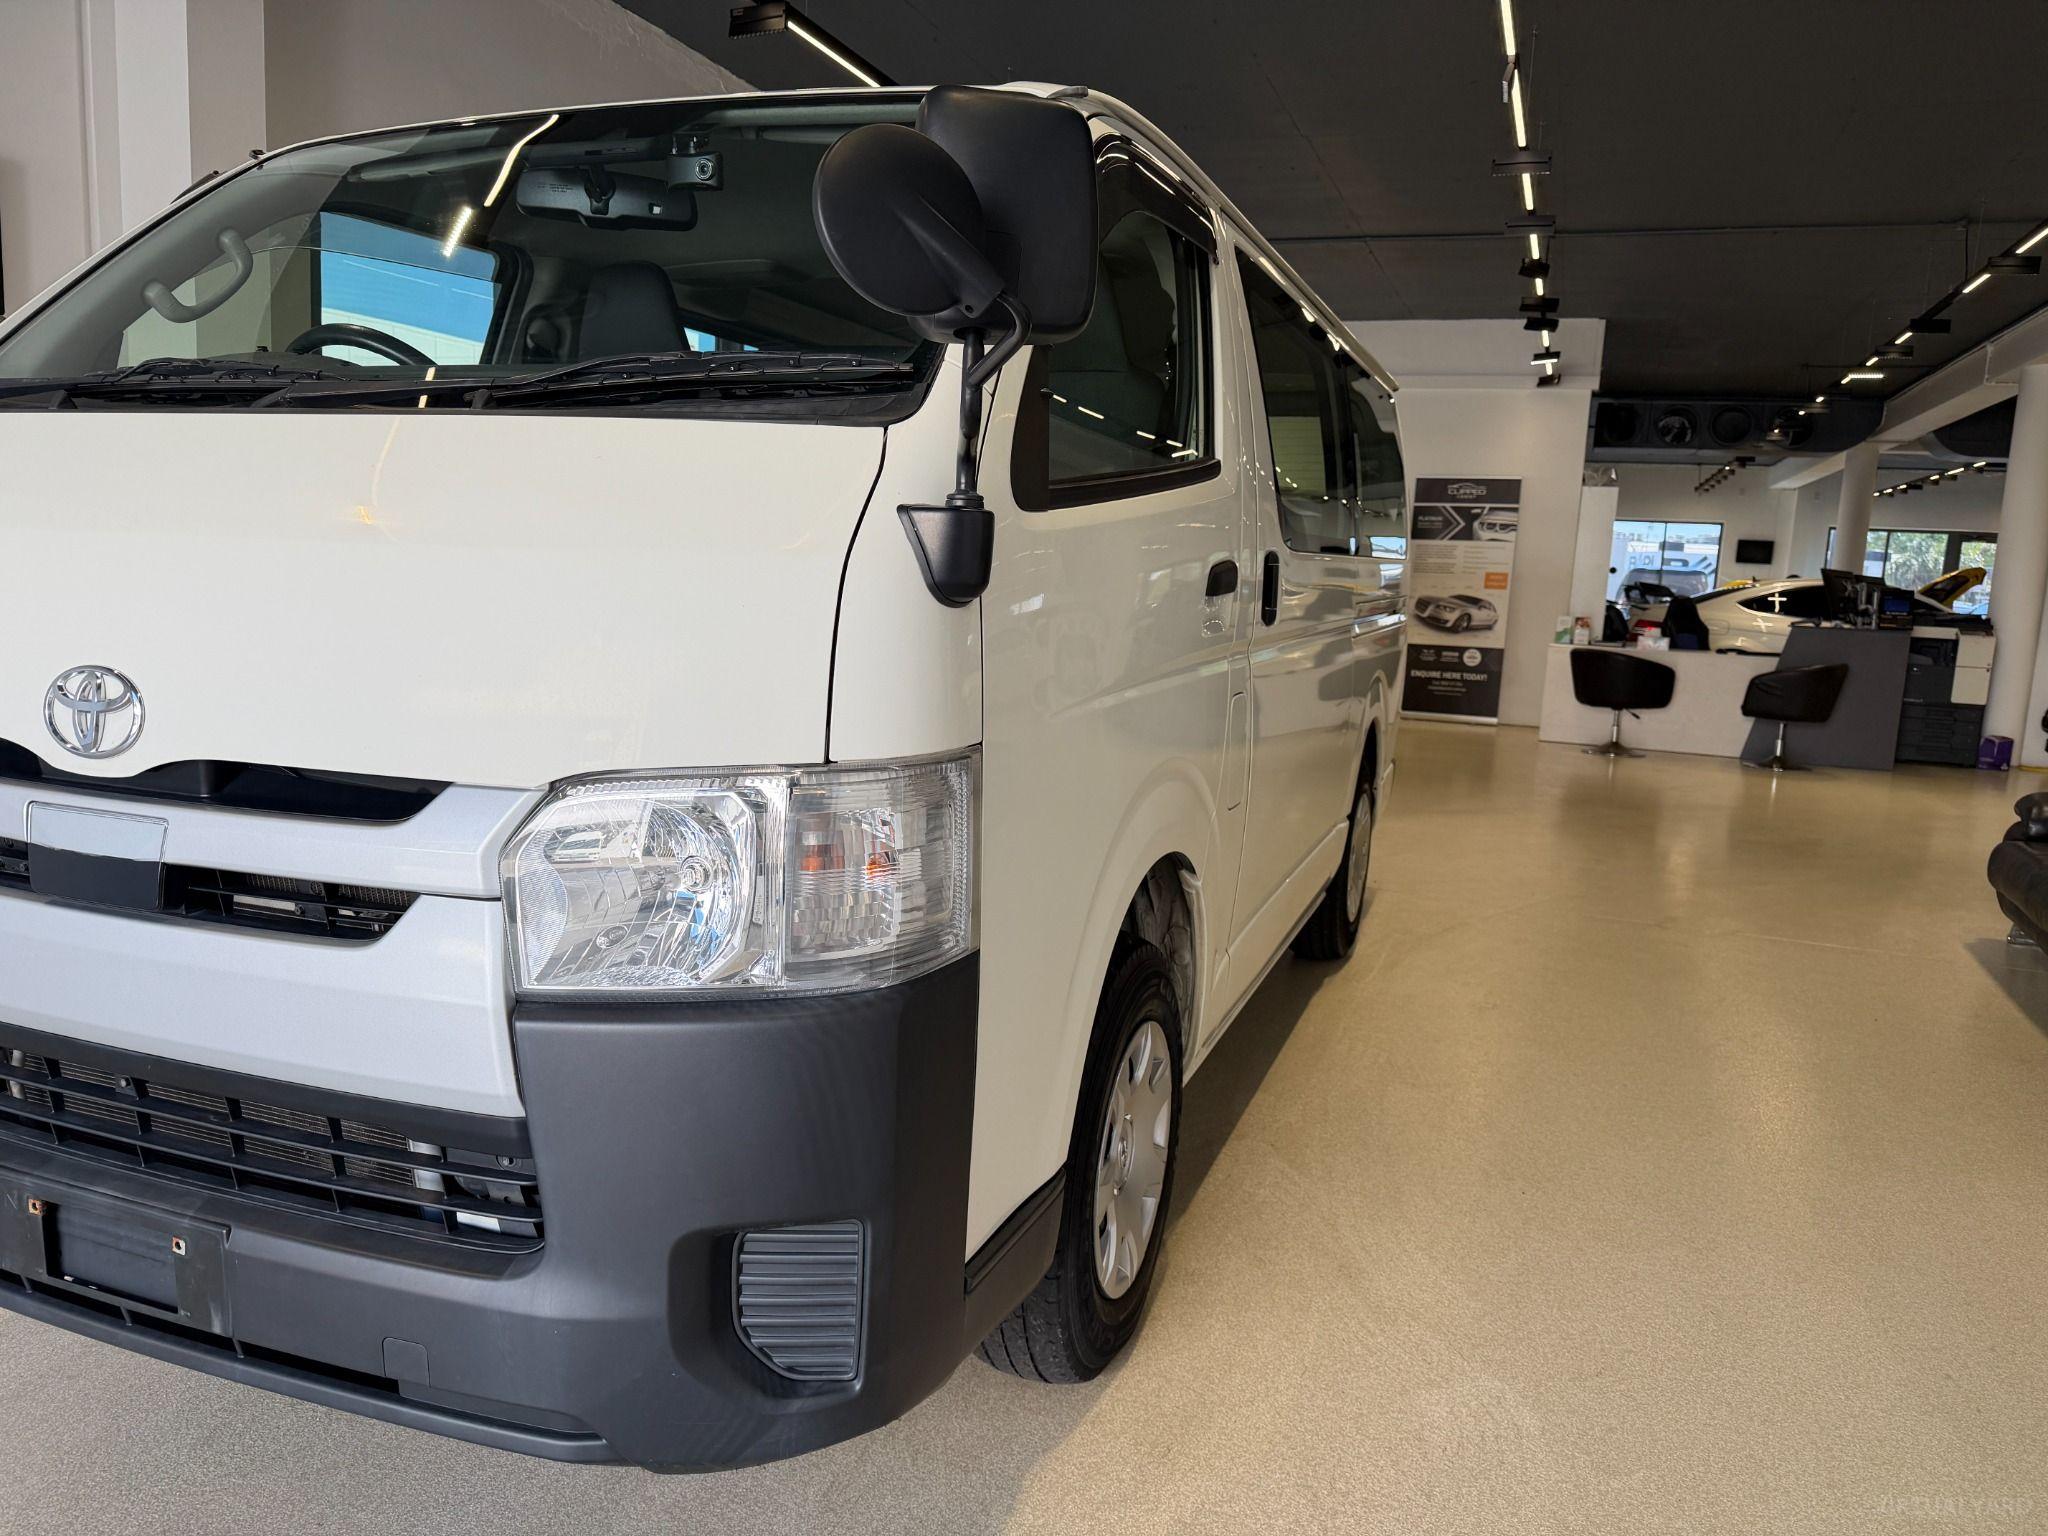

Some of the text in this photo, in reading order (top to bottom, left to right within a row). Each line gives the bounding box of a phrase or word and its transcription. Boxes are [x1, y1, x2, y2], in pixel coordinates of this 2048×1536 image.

[1410, 669, 1488, 682] ENQUIRE HERE TODAY!
